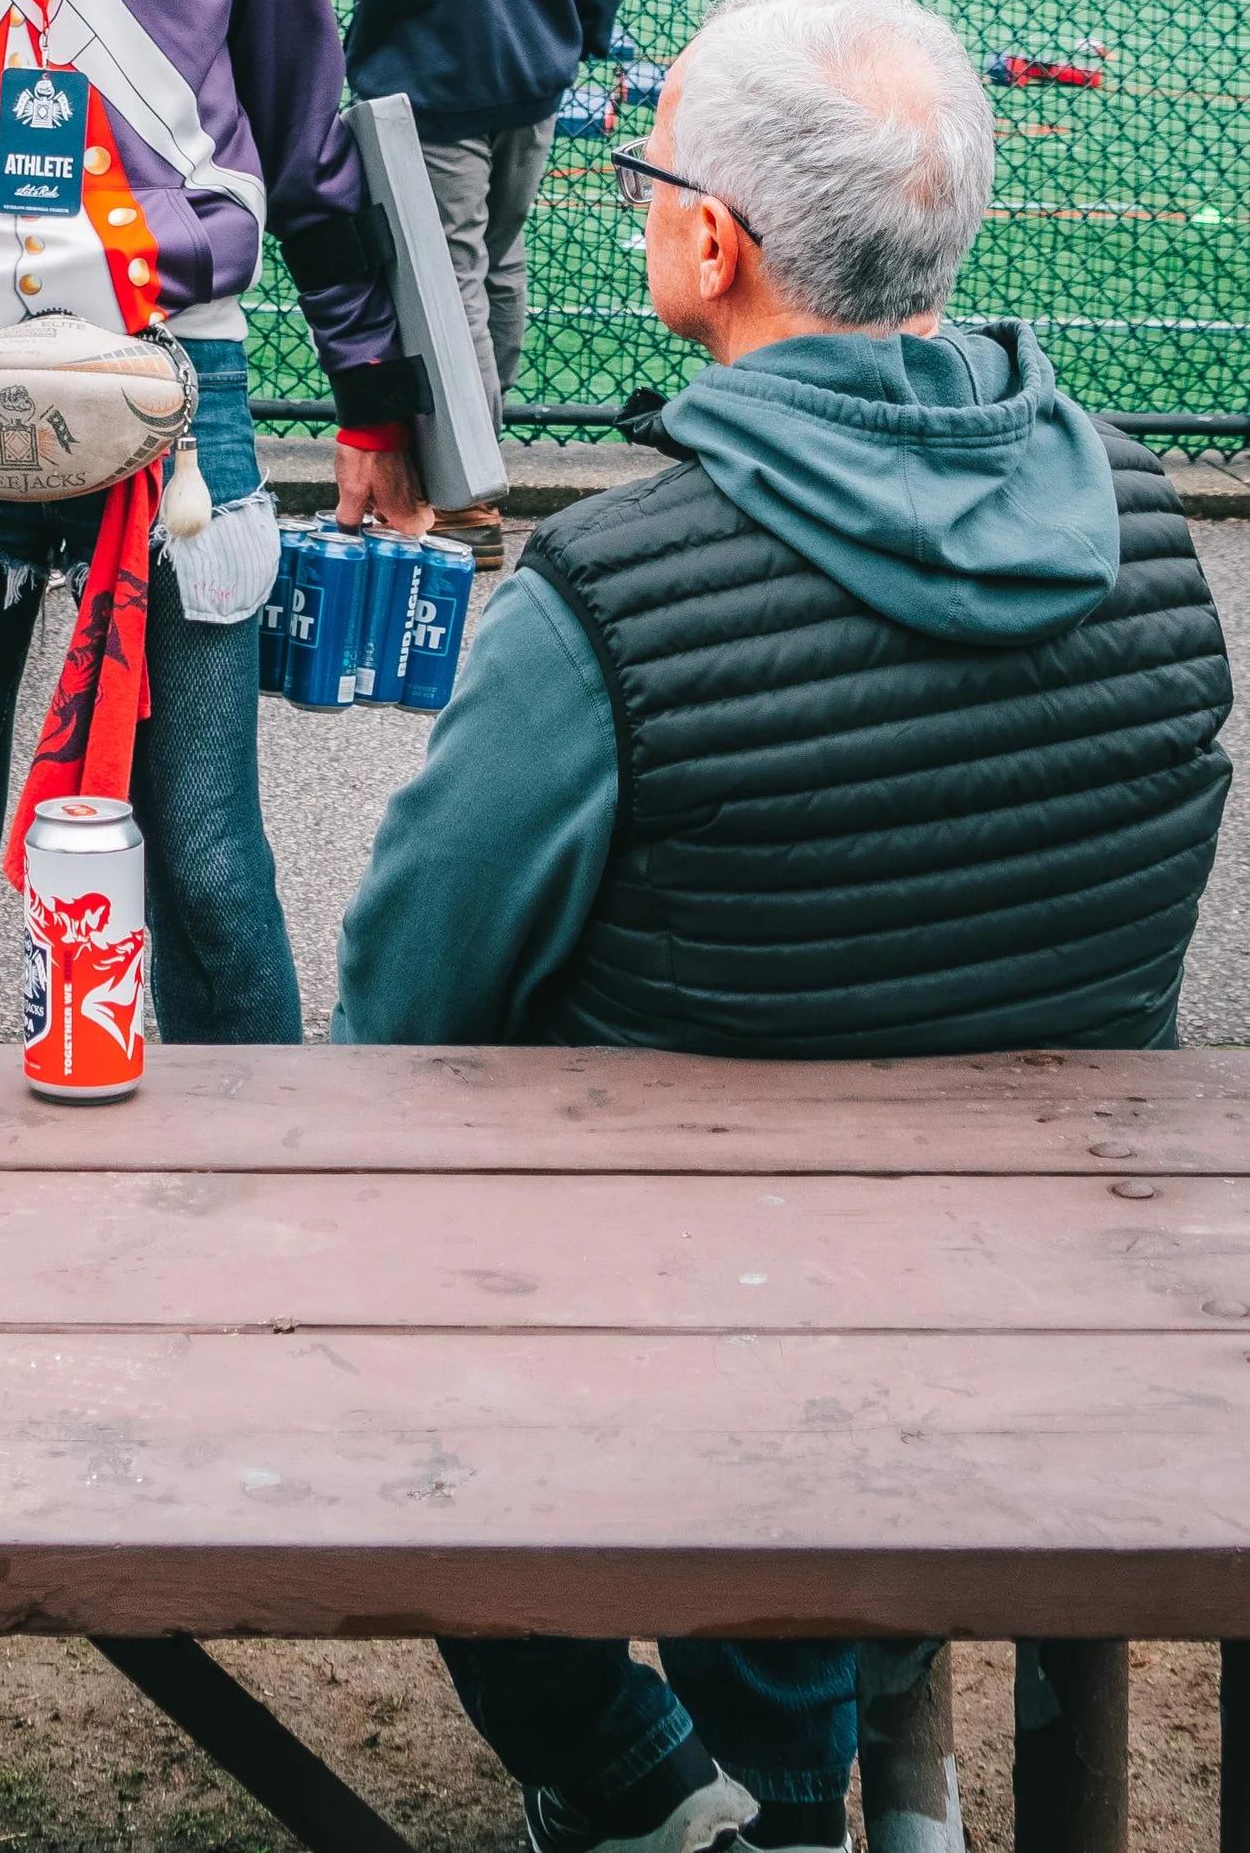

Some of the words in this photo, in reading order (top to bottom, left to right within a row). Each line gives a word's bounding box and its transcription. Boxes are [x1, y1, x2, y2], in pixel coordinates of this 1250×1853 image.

[4, 154, 74, 178] ATHLETE
[397, 631, 411, 677] BUD
[405, 565, 422, 628] LIGHT
[64, 983, 73, 1005] WE
[64, 1007, 73, 1076] TOGETHER
